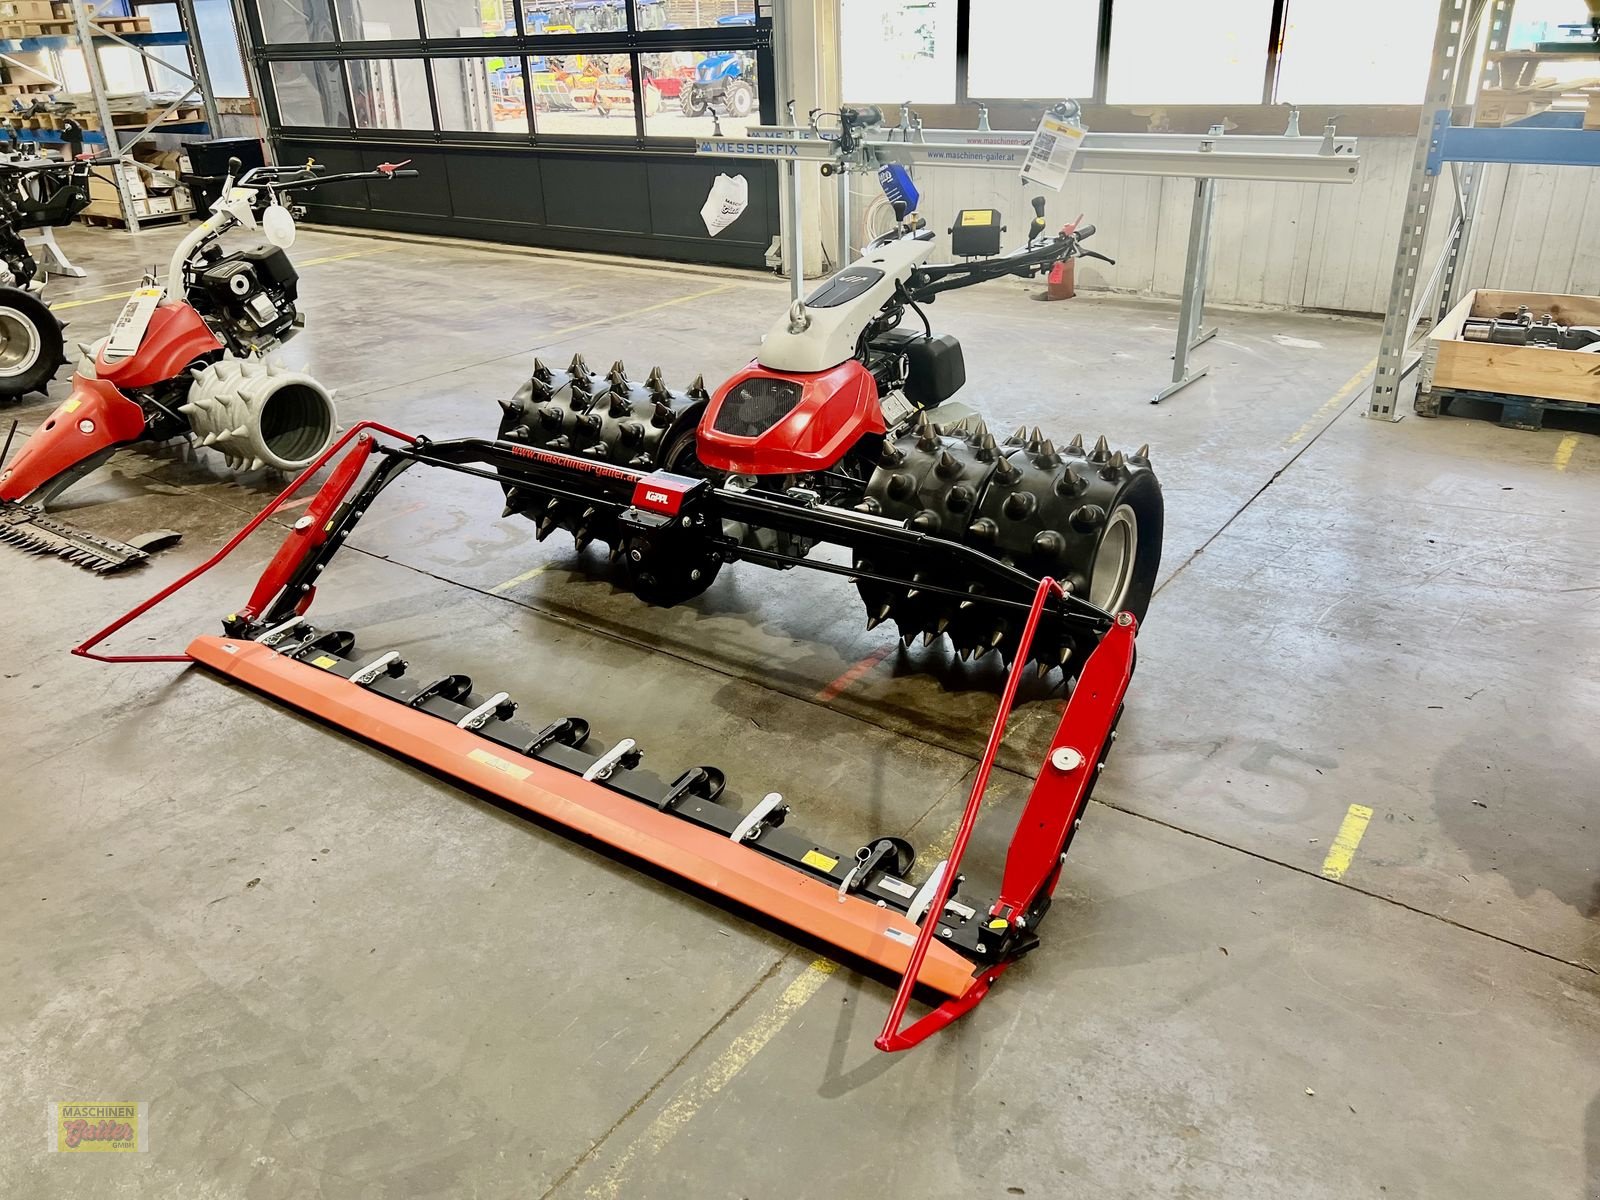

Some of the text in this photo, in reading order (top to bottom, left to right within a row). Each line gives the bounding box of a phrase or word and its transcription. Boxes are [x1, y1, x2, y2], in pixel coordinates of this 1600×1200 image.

[716, 142, 799, 155] MESSERFIX
[927, 151, 1015, 162] www.maschinen-gailer.at
[511, 445, 638, 482] www.maschinen-gailer.at
